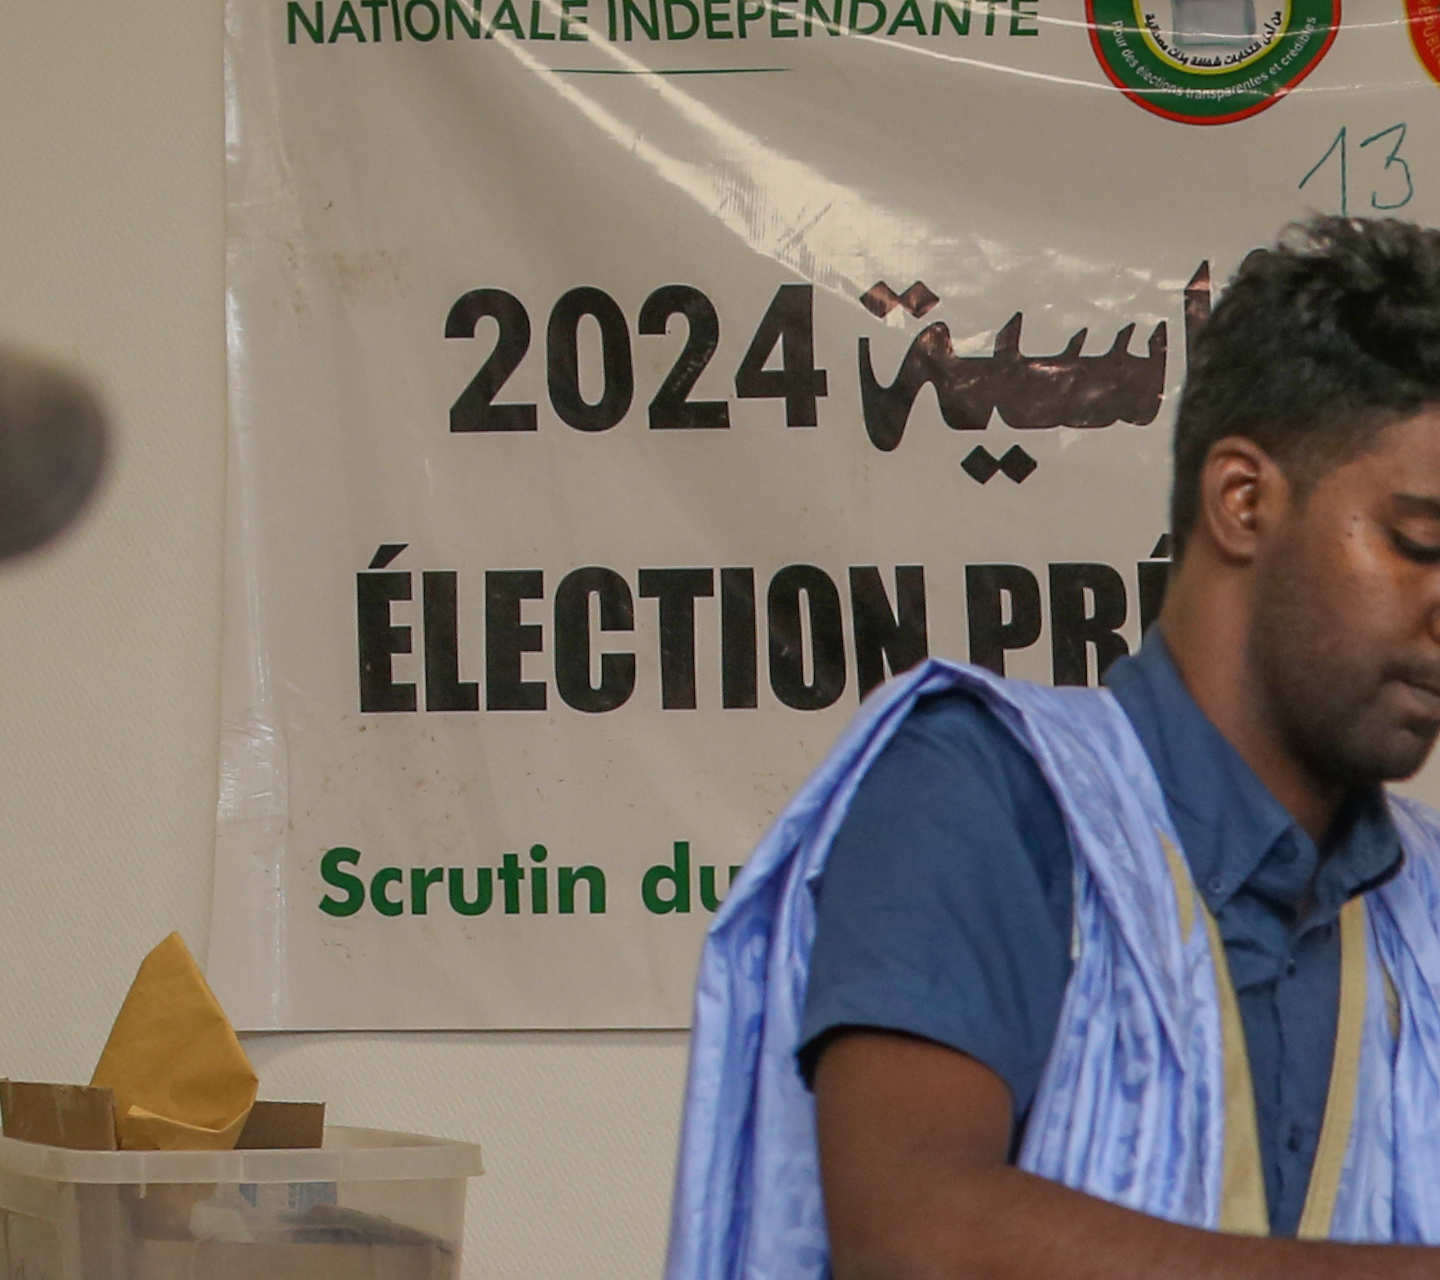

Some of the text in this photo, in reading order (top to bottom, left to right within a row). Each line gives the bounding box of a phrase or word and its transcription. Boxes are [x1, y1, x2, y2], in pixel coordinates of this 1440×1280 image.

[286, 0, 589, 44] NATIONALE
[1110, 19, 1128, 51] Pour
[1121, 46, 1139, 67] des
[1184, 70, 1270, 102] transparentes
[1267, 63, 1283, 76] et
[1280, 16, 1318, 67] crédibles
[1298, 122, 1414, 216] 13
[443, 284, 829, 433] 2024
[355, 543, 931, 714] ÉLECTION
[318, 841, 746, 917] Scrutin du
